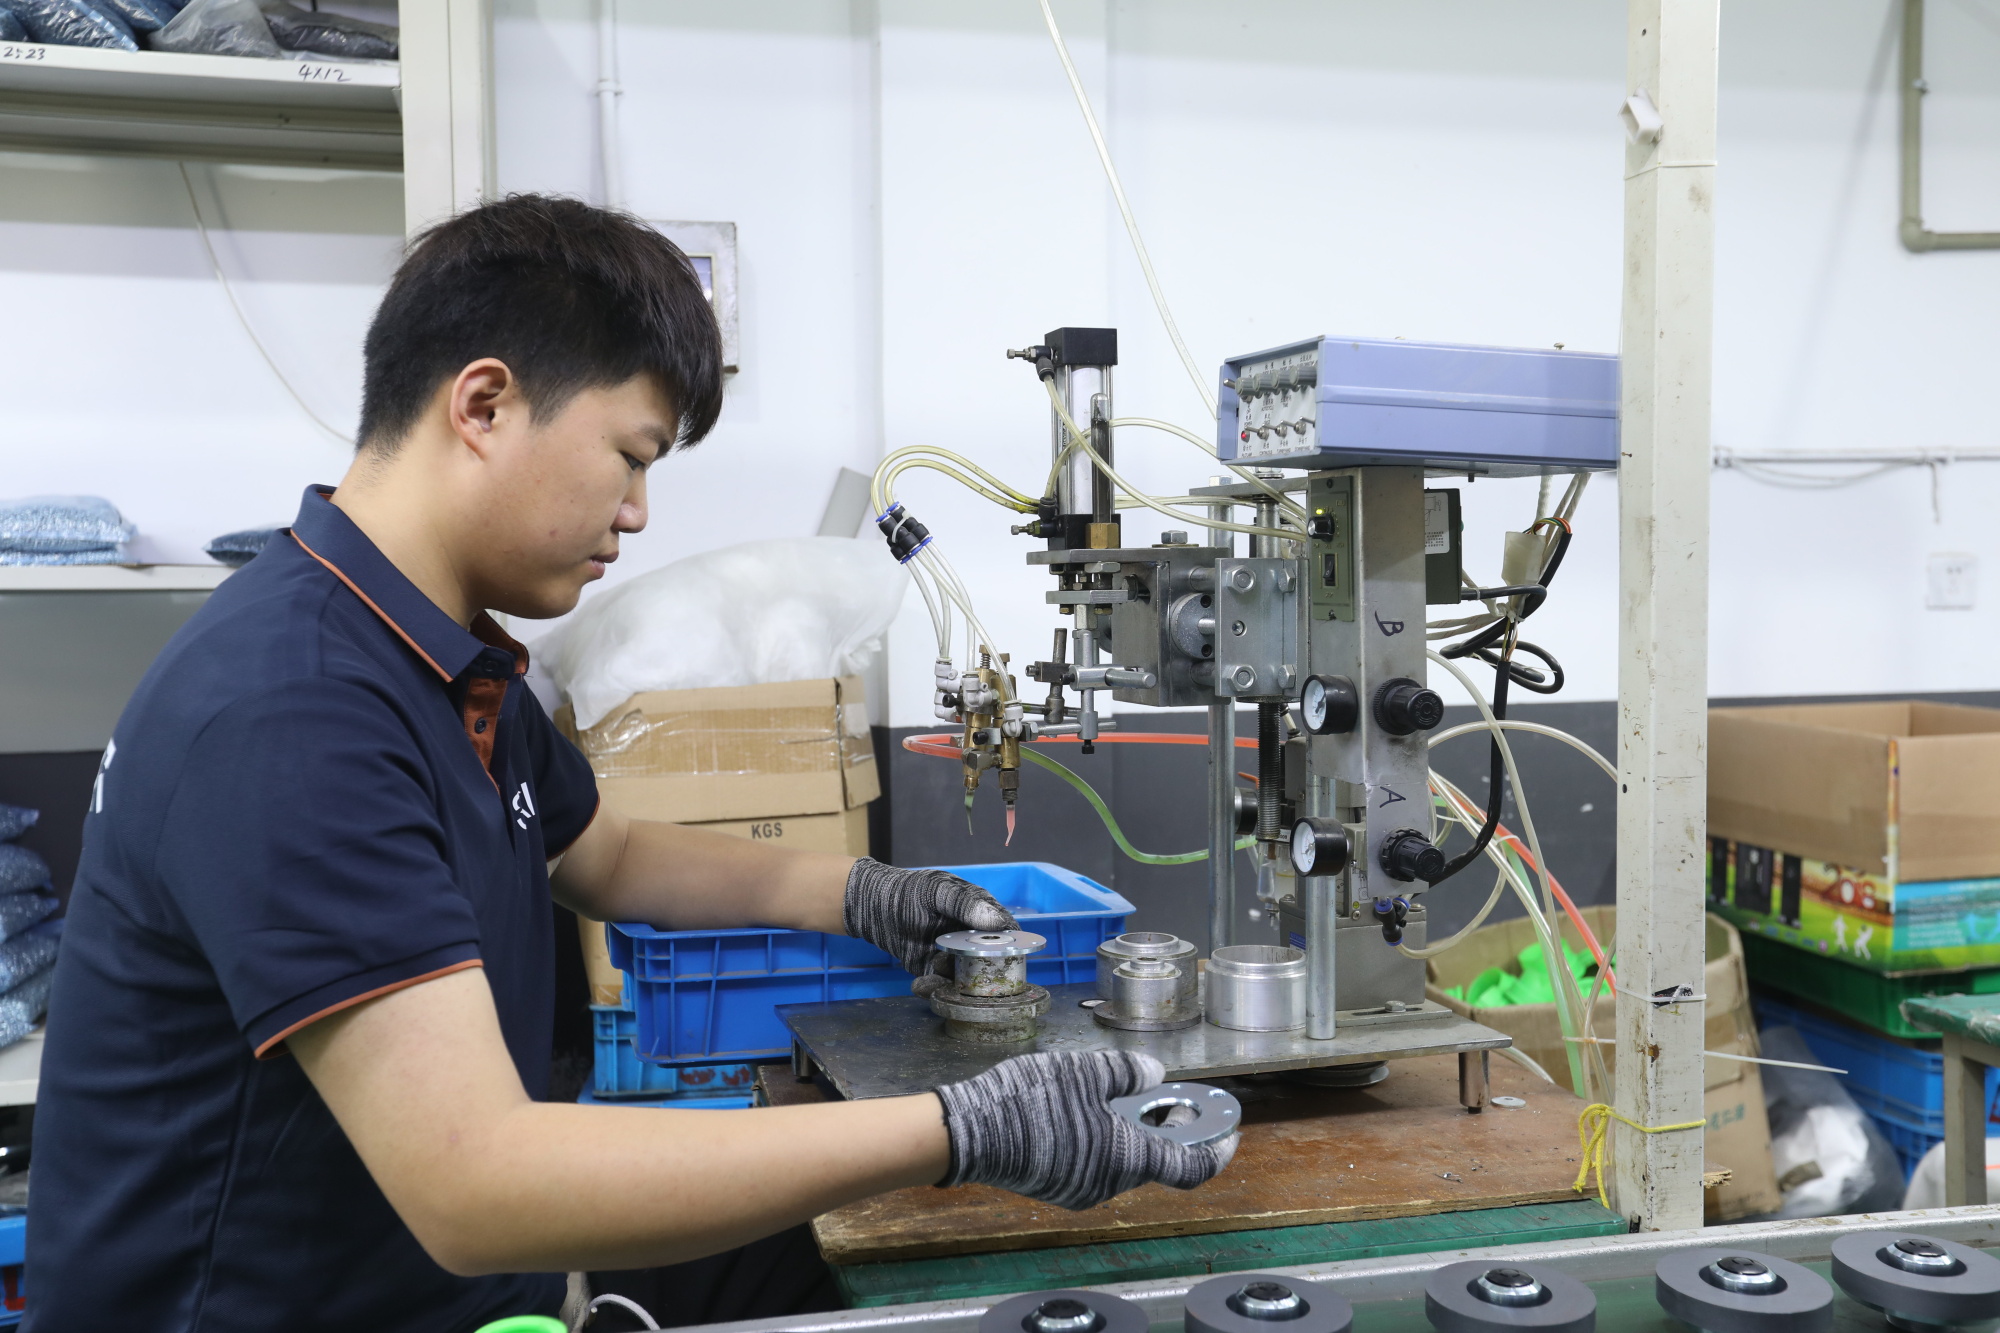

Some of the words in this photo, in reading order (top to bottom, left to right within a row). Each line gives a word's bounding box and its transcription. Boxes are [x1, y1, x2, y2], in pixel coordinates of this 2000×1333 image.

[1374, 610, 1405, 637] B
[1379, 786, 1407, 809] A
[751, 822, 783, 840] KGS
